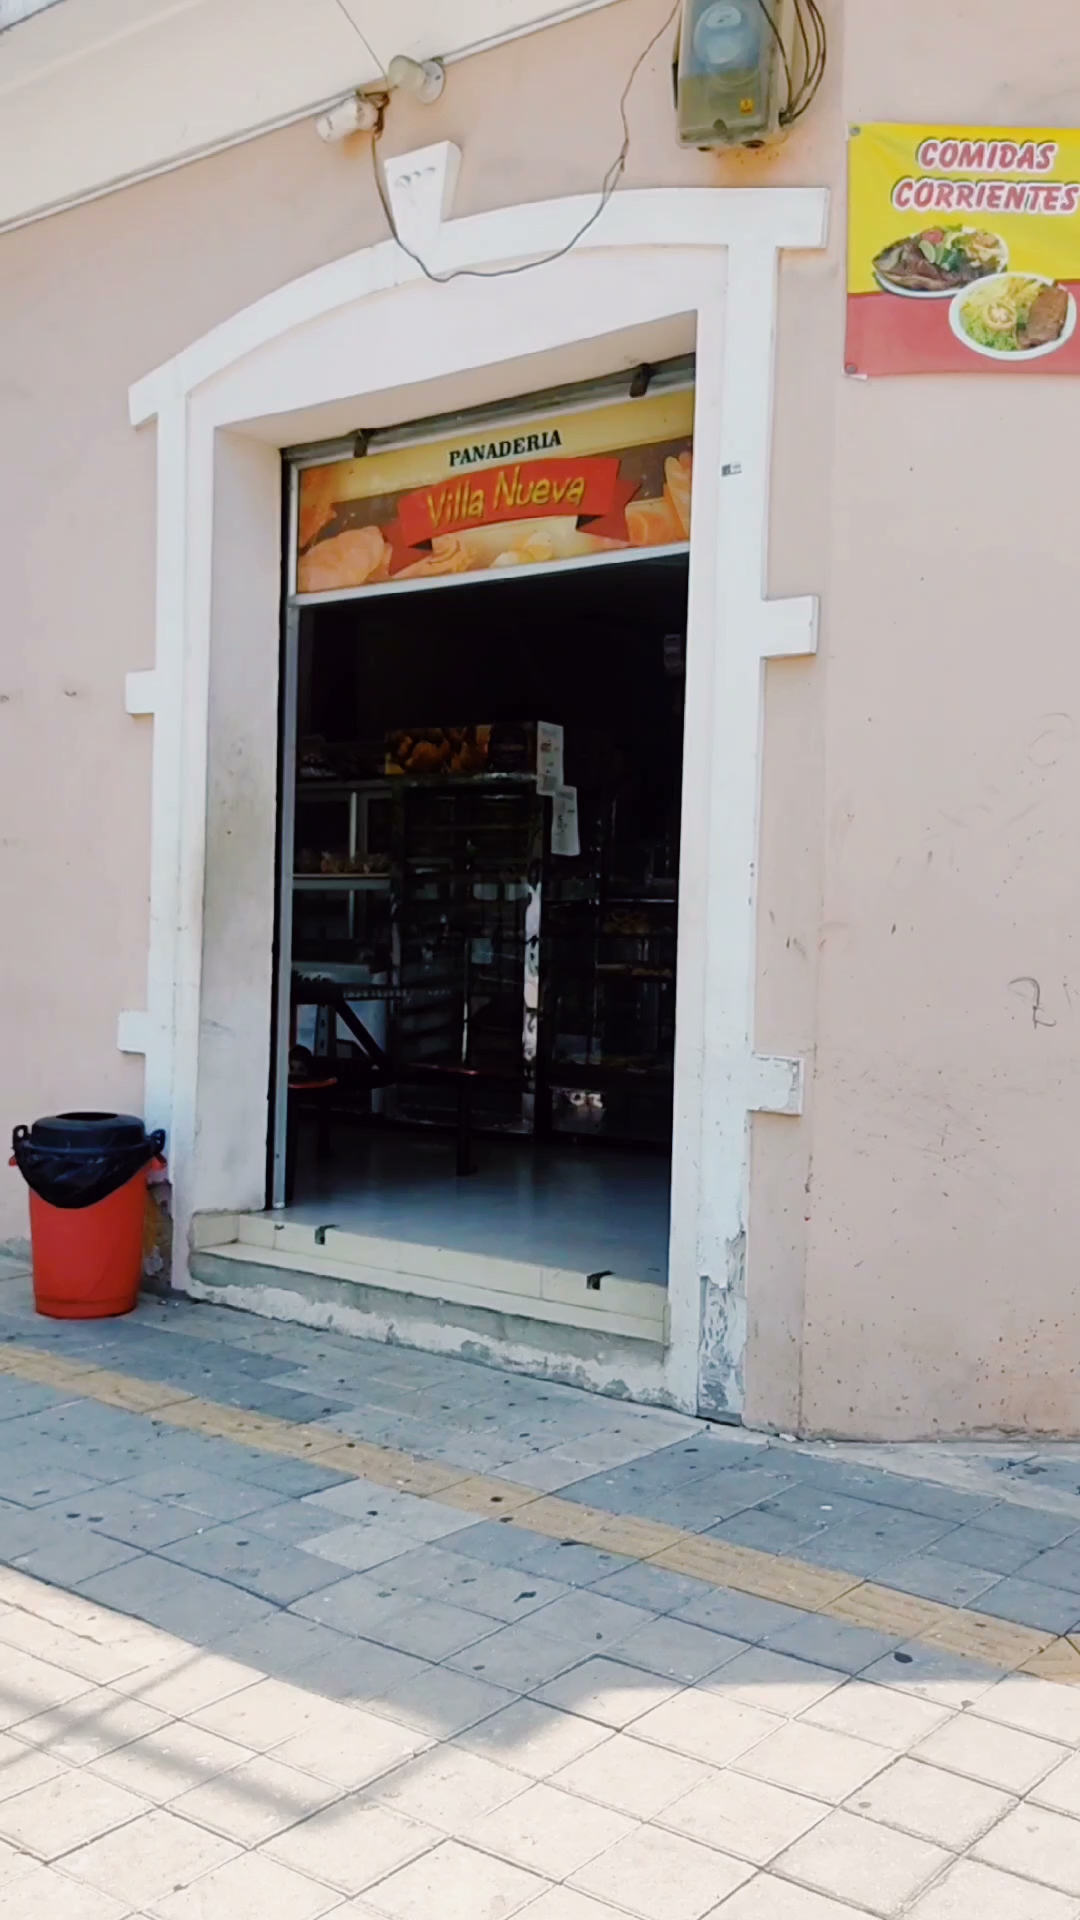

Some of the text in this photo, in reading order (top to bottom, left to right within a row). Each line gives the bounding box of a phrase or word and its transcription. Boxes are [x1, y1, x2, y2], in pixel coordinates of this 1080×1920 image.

[917, 138, 1057, 172] COMIDAS
[891, 176, 1080, 213] CORRIENTES
[449, 429, 562, 467] PANADERIA
[427, 466, 586, 529] Villa Nueva
